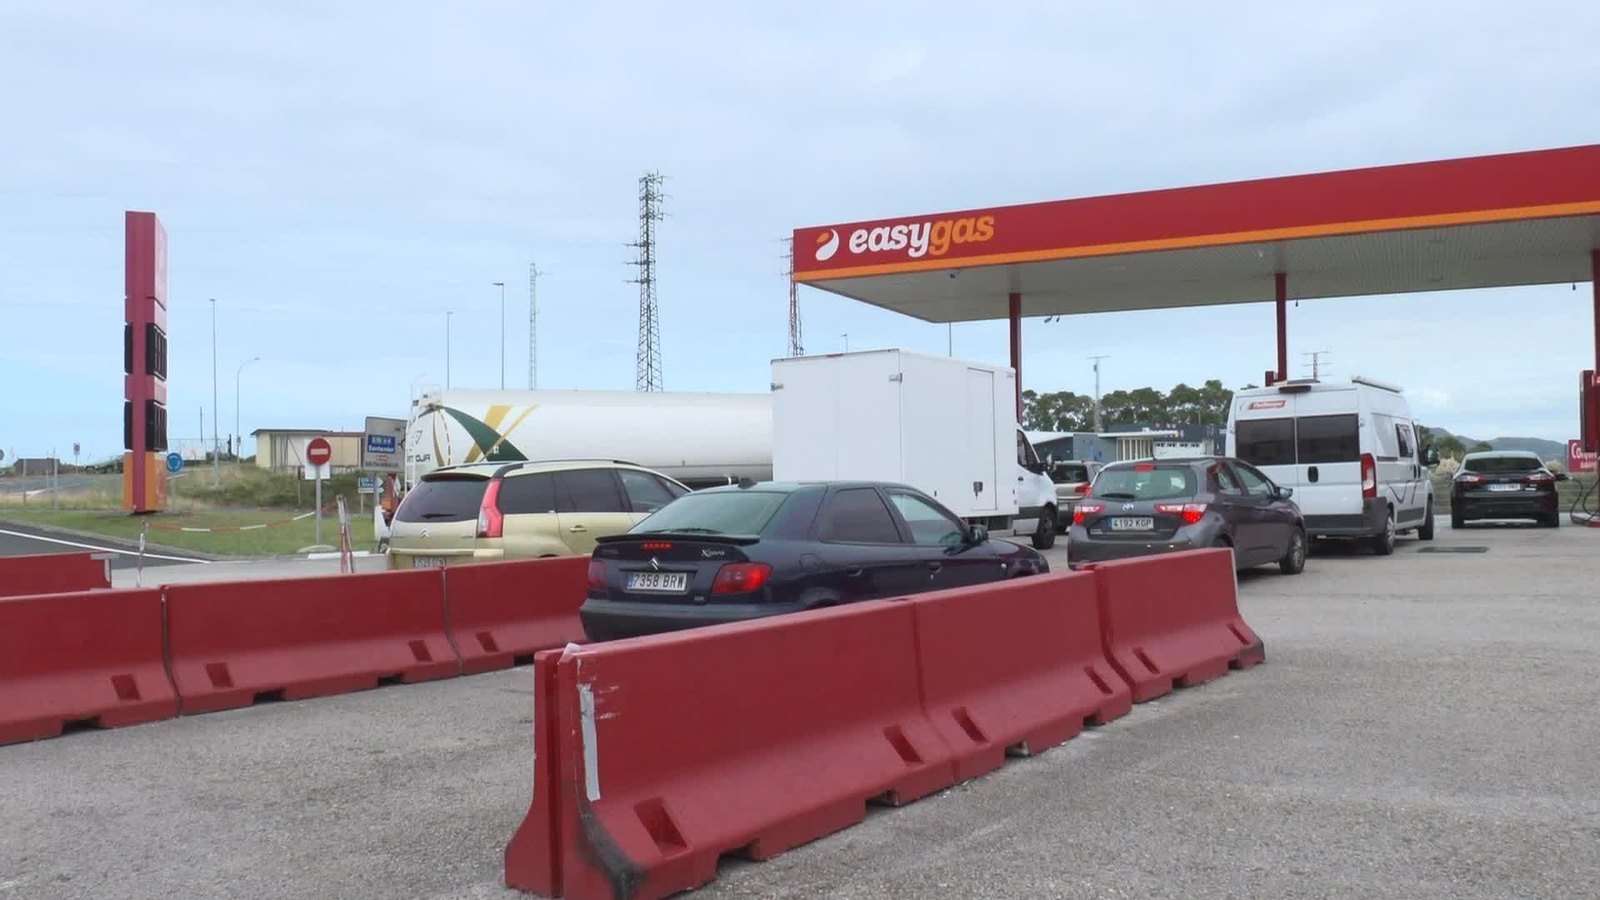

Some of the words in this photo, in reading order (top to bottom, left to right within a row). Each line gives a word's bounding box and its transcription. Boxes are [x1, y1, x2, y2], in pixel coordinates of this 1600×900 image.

[849, 216, 995, 258] easygas
[1113, 517, 1134, 528] 4192
[1135, 517, 1152, 527] KGP
[632, 572, 659, 588] 7358
[662, 573, 685, 588] BRW
